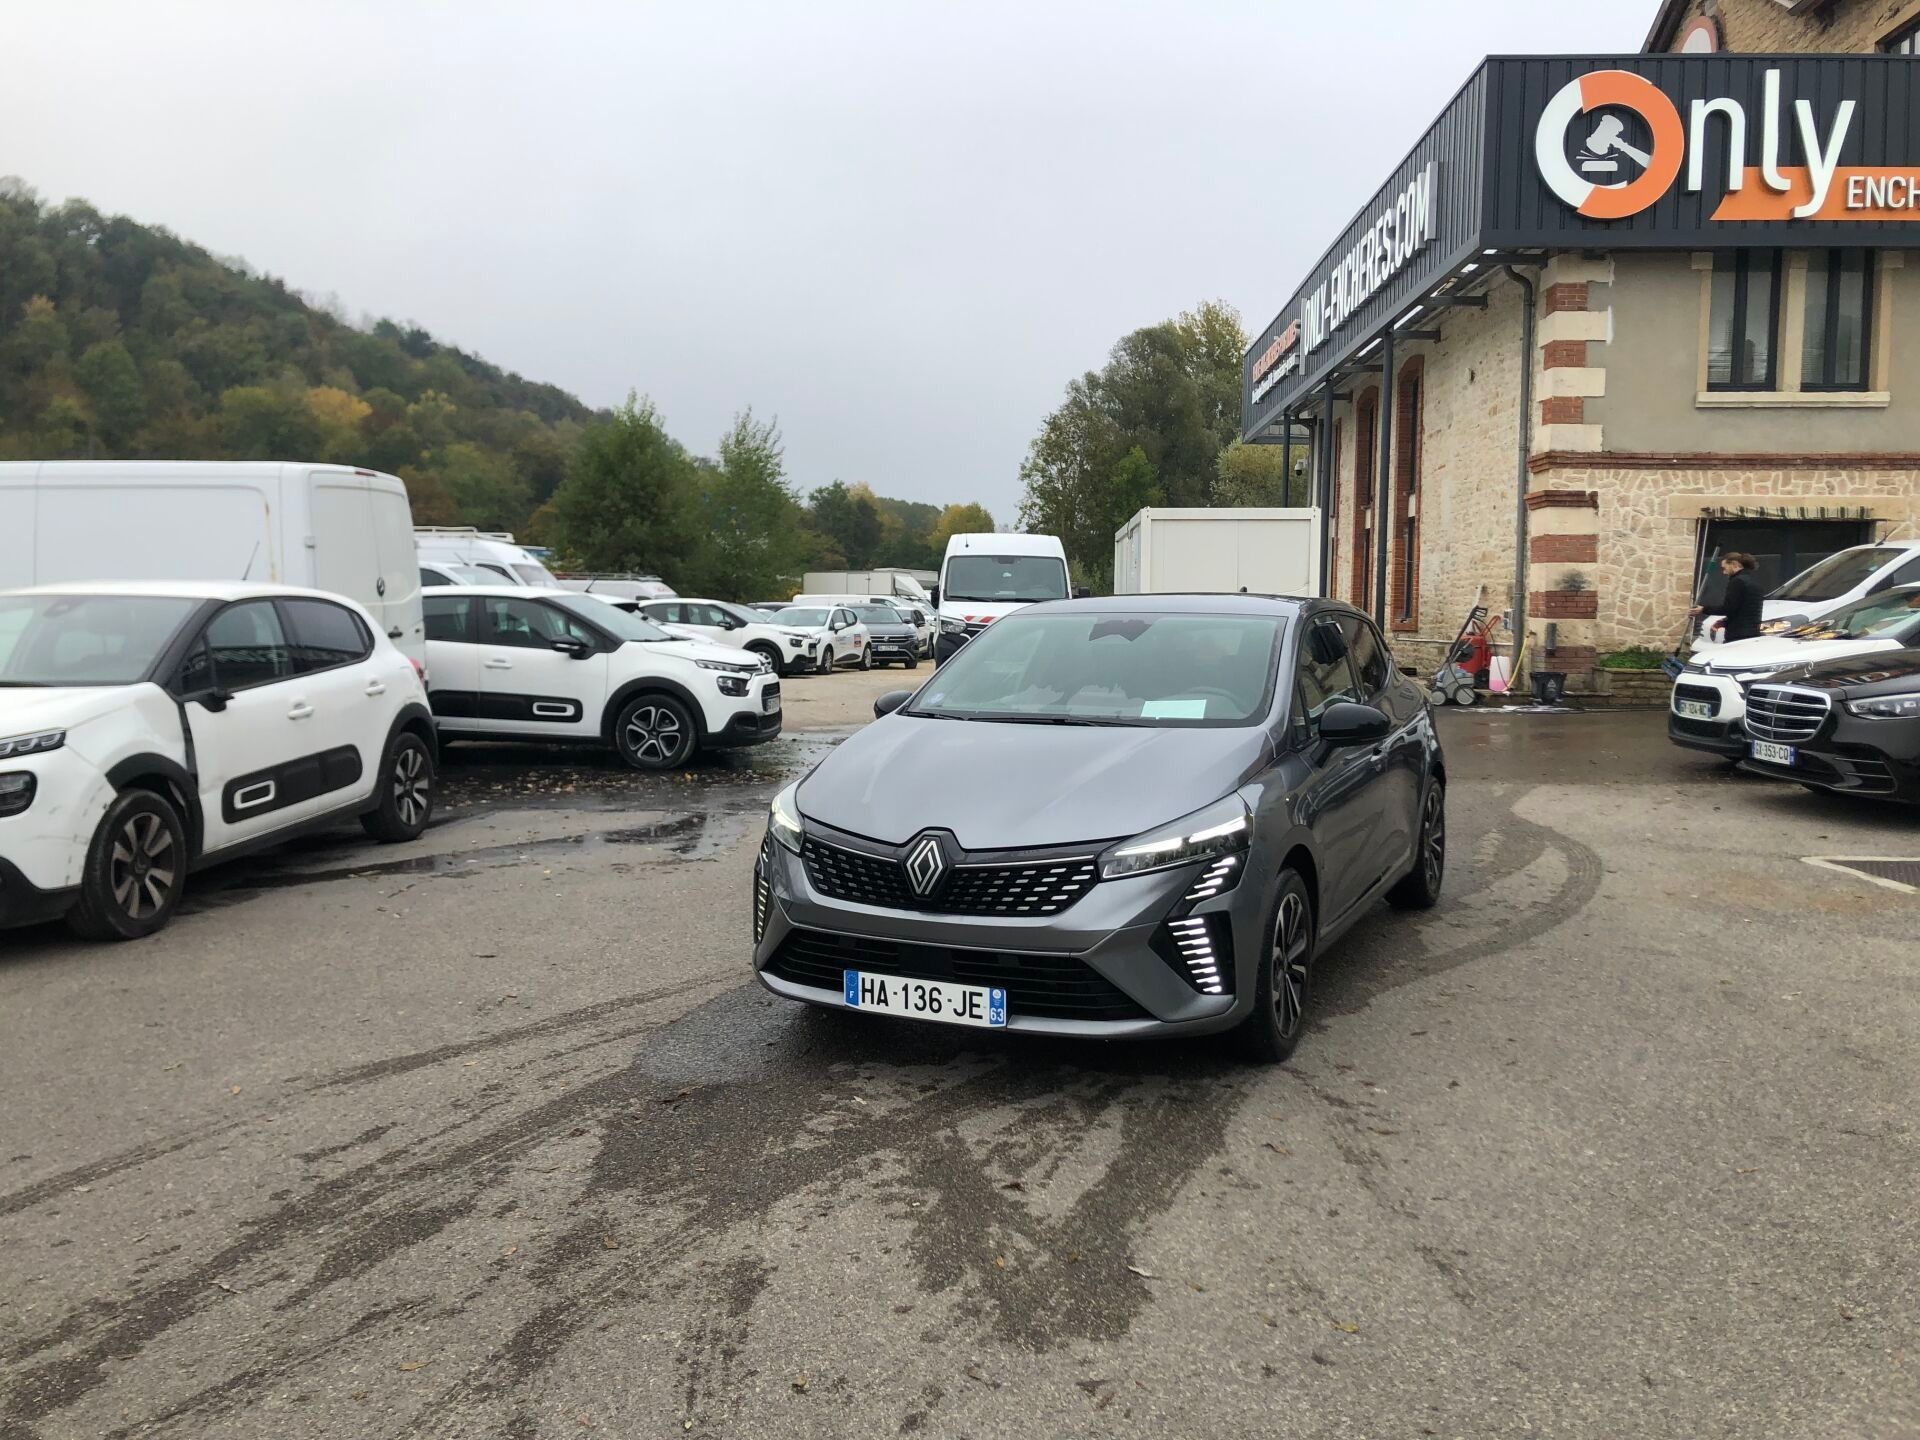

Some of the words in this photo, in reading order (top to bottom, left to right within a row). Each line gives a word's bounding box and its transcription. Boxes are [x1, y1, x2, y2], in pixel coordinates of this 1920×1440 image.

[1536, 69, 1856, 218] Only
[1304, 162, 1431, 356] ONLY-ENCHERES.COM
[861, 977, 983, 1019] HA-136-JE
[990, 1008, 1003, 1022] 63
